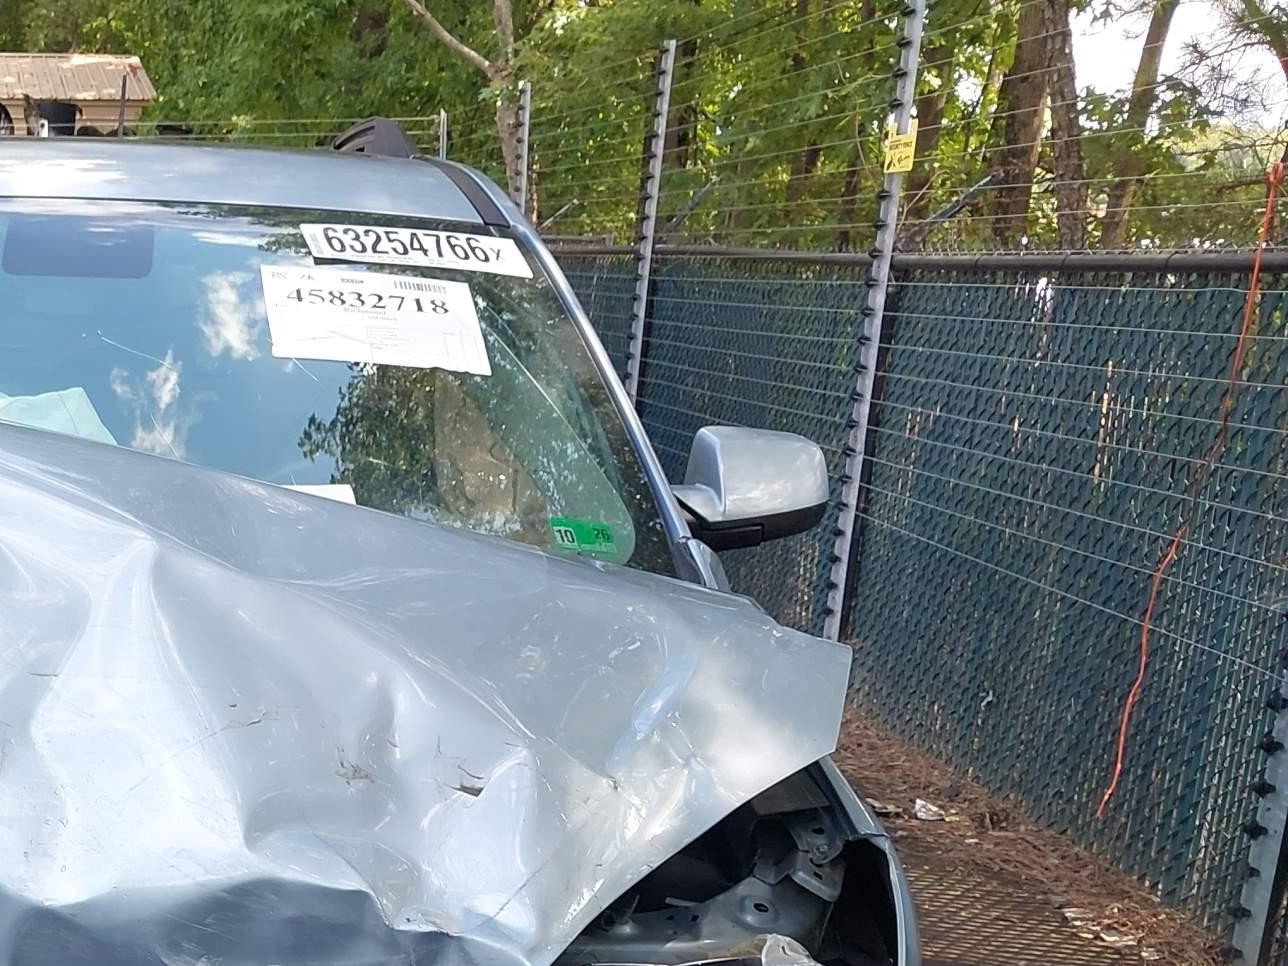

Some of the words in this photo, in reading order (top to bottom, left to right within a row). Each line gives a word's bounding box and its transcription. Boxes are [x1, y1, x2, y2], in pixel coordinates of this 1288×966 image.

[323, 227, 490, 263] 63254766
[286, 286, 450, 315] 45832718
[555, 528, 576, 544] 10
